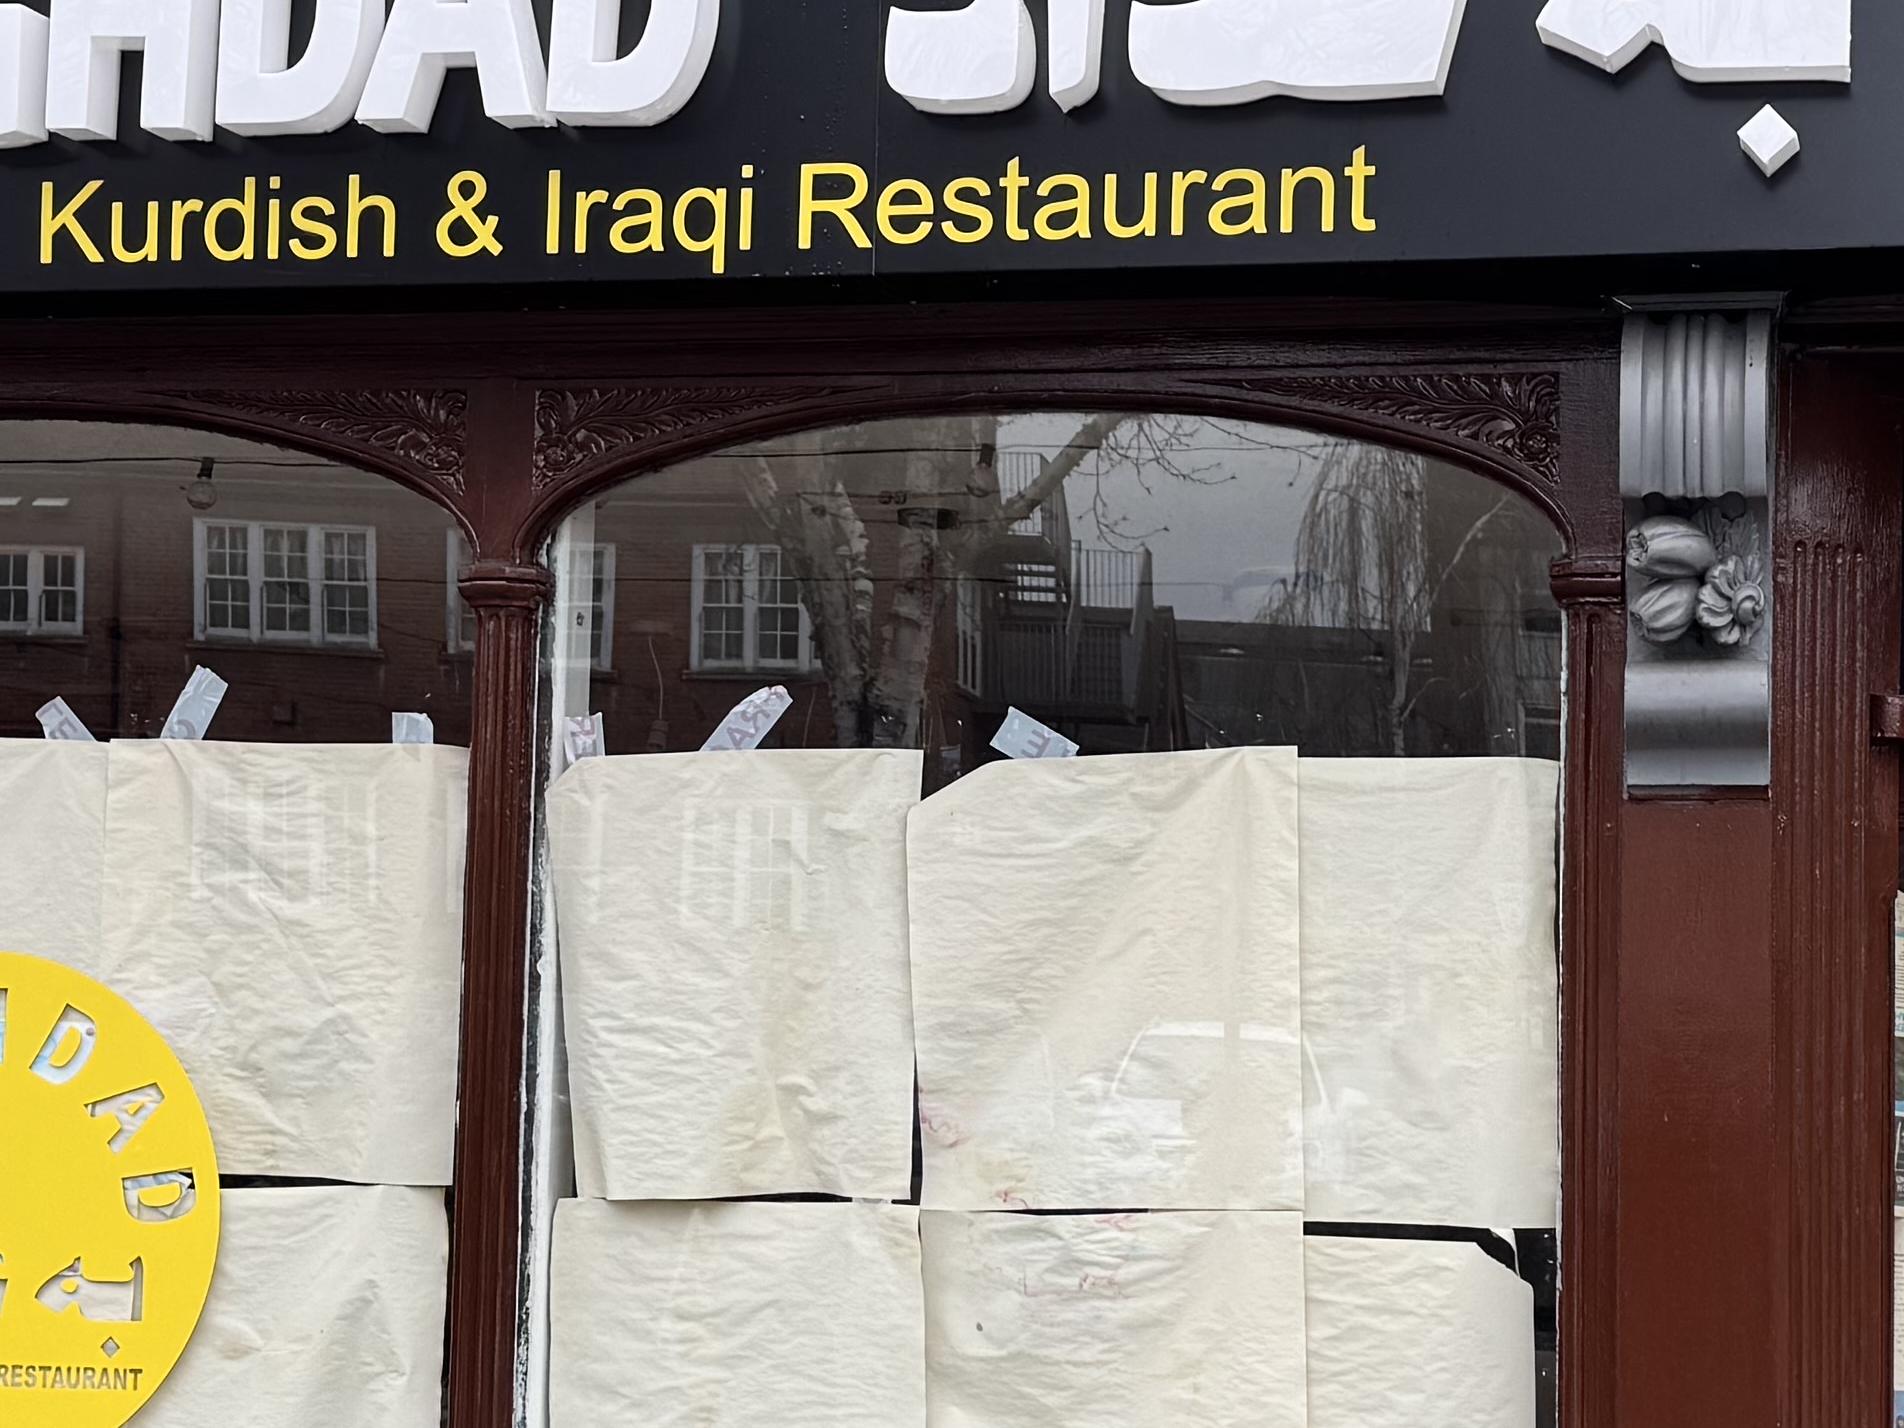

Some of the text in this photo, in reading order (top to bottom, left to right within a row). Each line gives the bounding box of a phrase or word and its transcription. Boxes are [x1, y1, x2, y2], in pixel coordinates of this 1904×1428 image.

[37, 147, 1377, 274] Kurdish & Iraqi Restaurant
